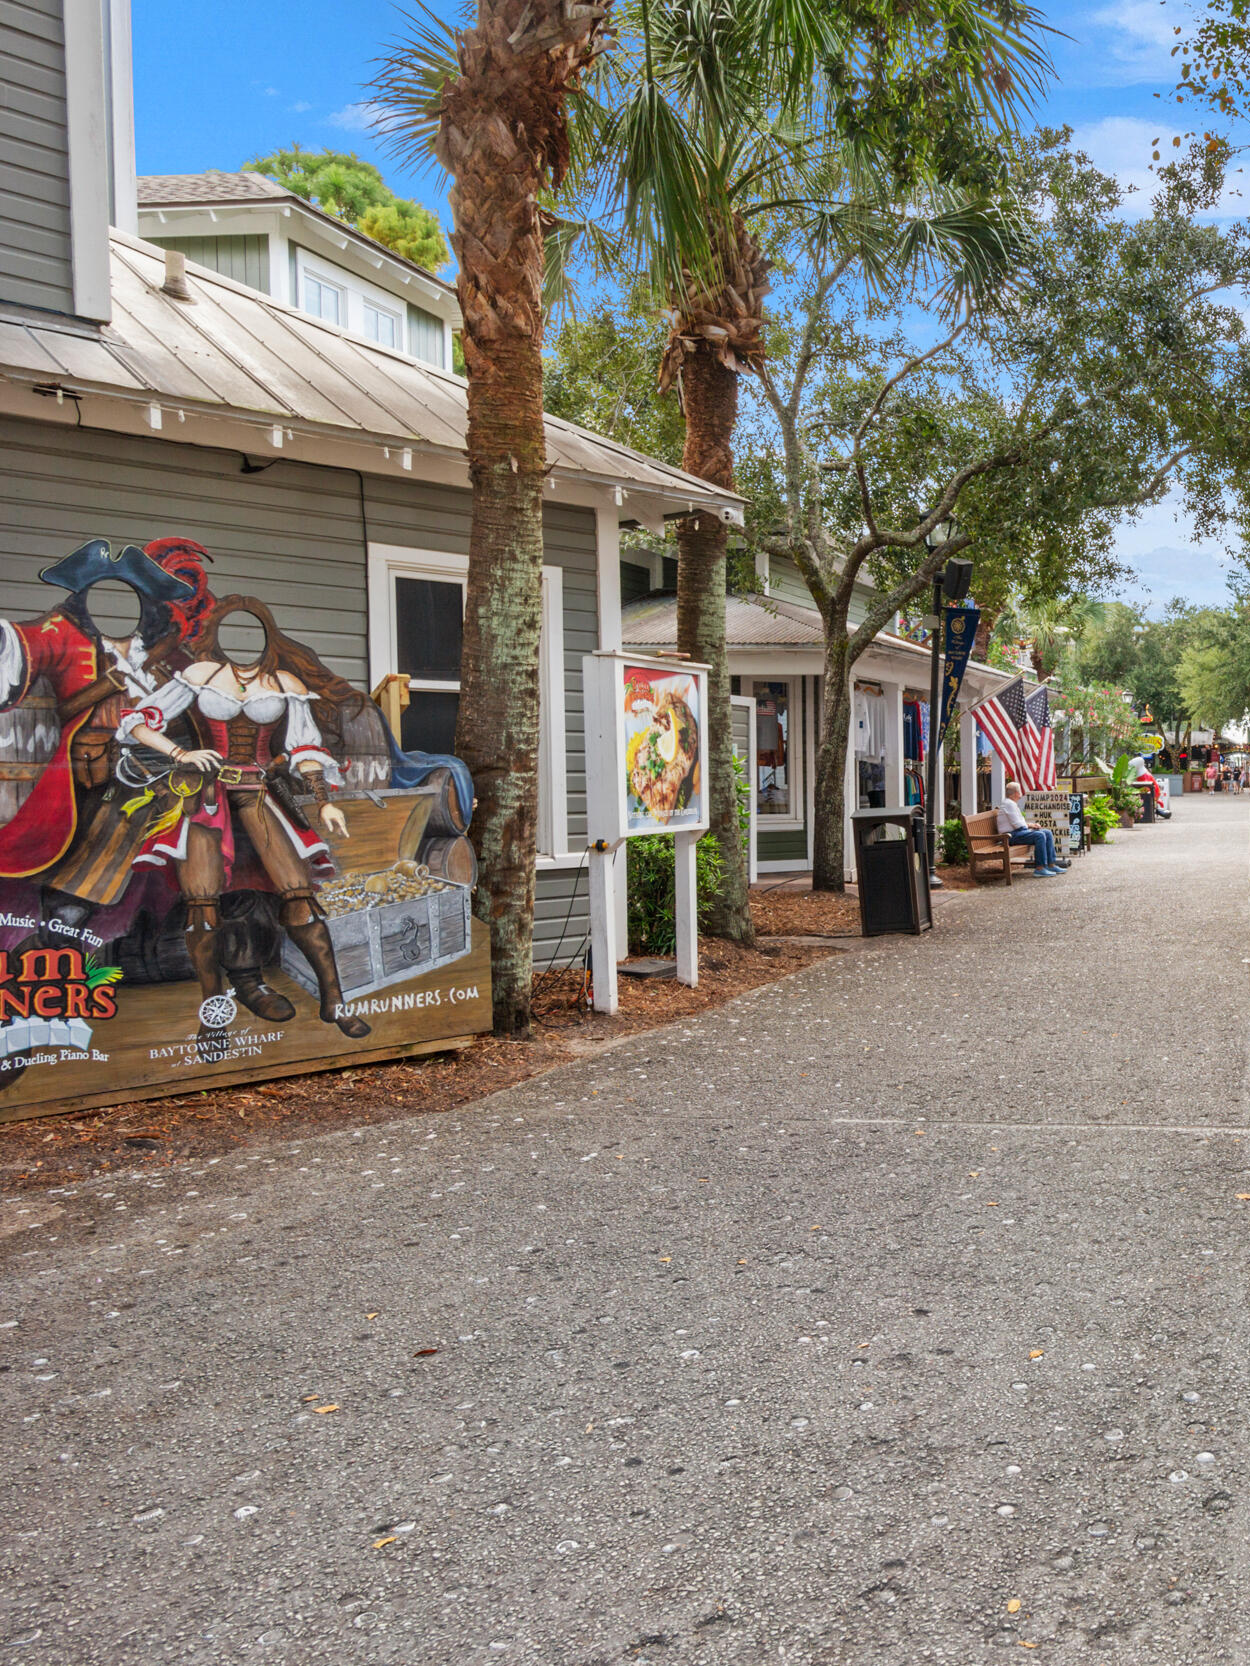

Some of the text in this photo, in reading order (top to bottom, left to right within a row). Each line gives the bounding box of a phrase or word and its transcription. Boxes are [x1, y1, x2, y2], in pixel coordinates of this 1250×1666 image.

[1039, 811, 1053, 819] HUK
[0, 912, 104, 947] Music Great Fun
[149, 1030, 286, 1059] BAYTOWNE WHARF
[184, 1045, 262, 1066] SANDESTIN
[0, 1049, 110, 1071] & Dueling Piano Bar
